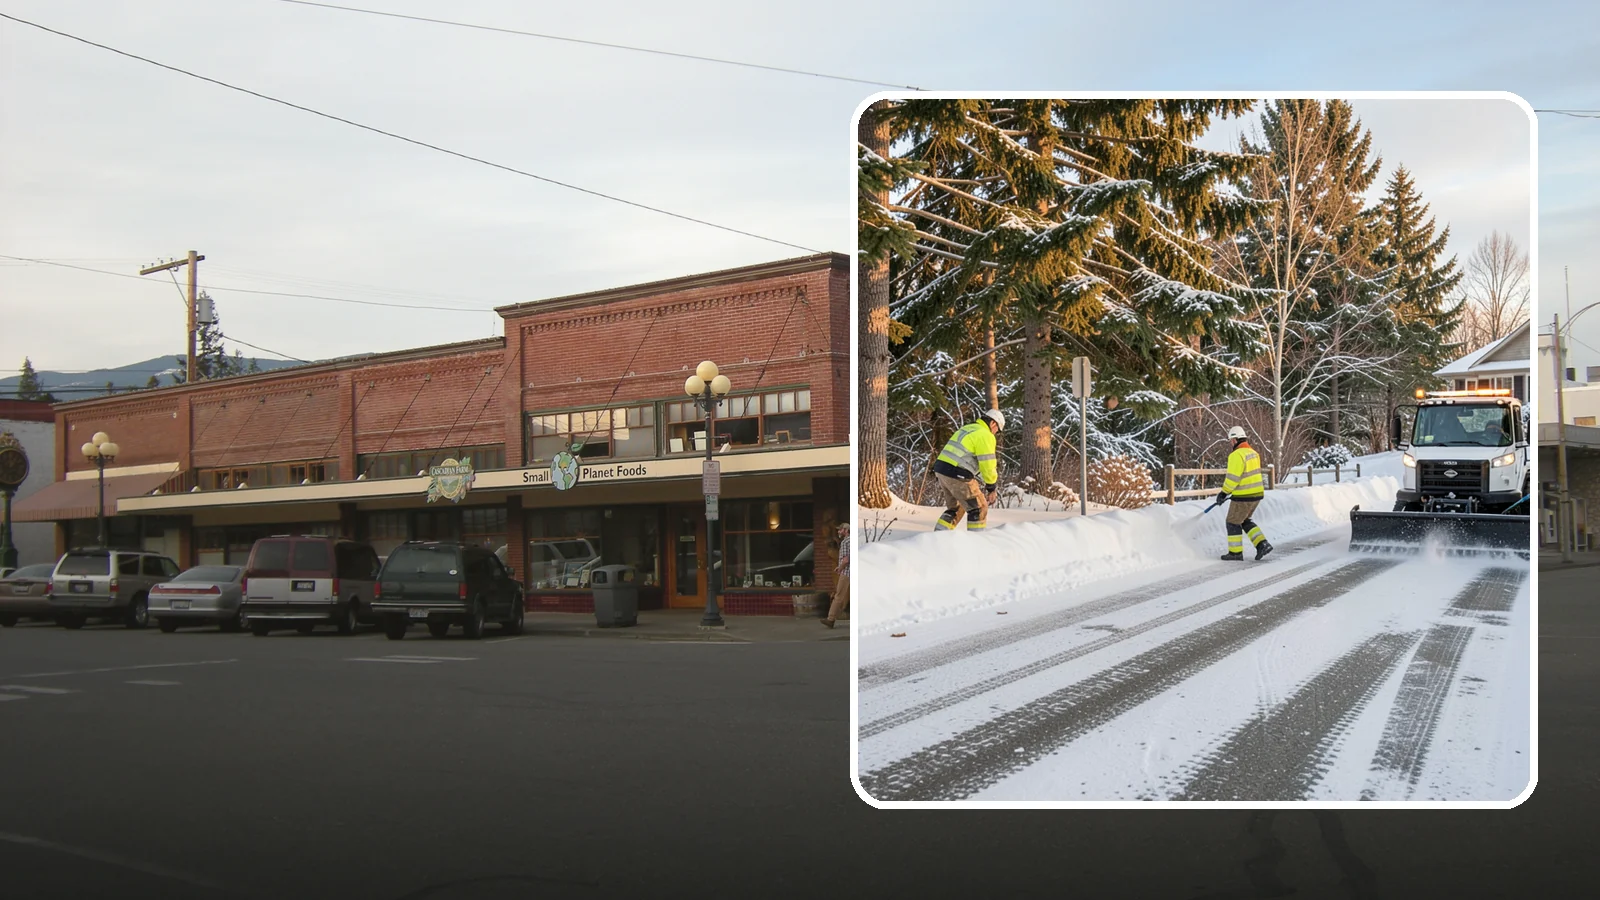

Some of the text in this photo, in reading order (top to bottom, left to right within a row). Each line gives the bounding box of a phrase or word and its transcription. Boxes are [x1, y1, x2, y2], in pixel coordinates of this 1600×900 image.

[431, 466, 456, 476] CASCADIAN
[523, 464, 647, 483] Small Planet Foods
